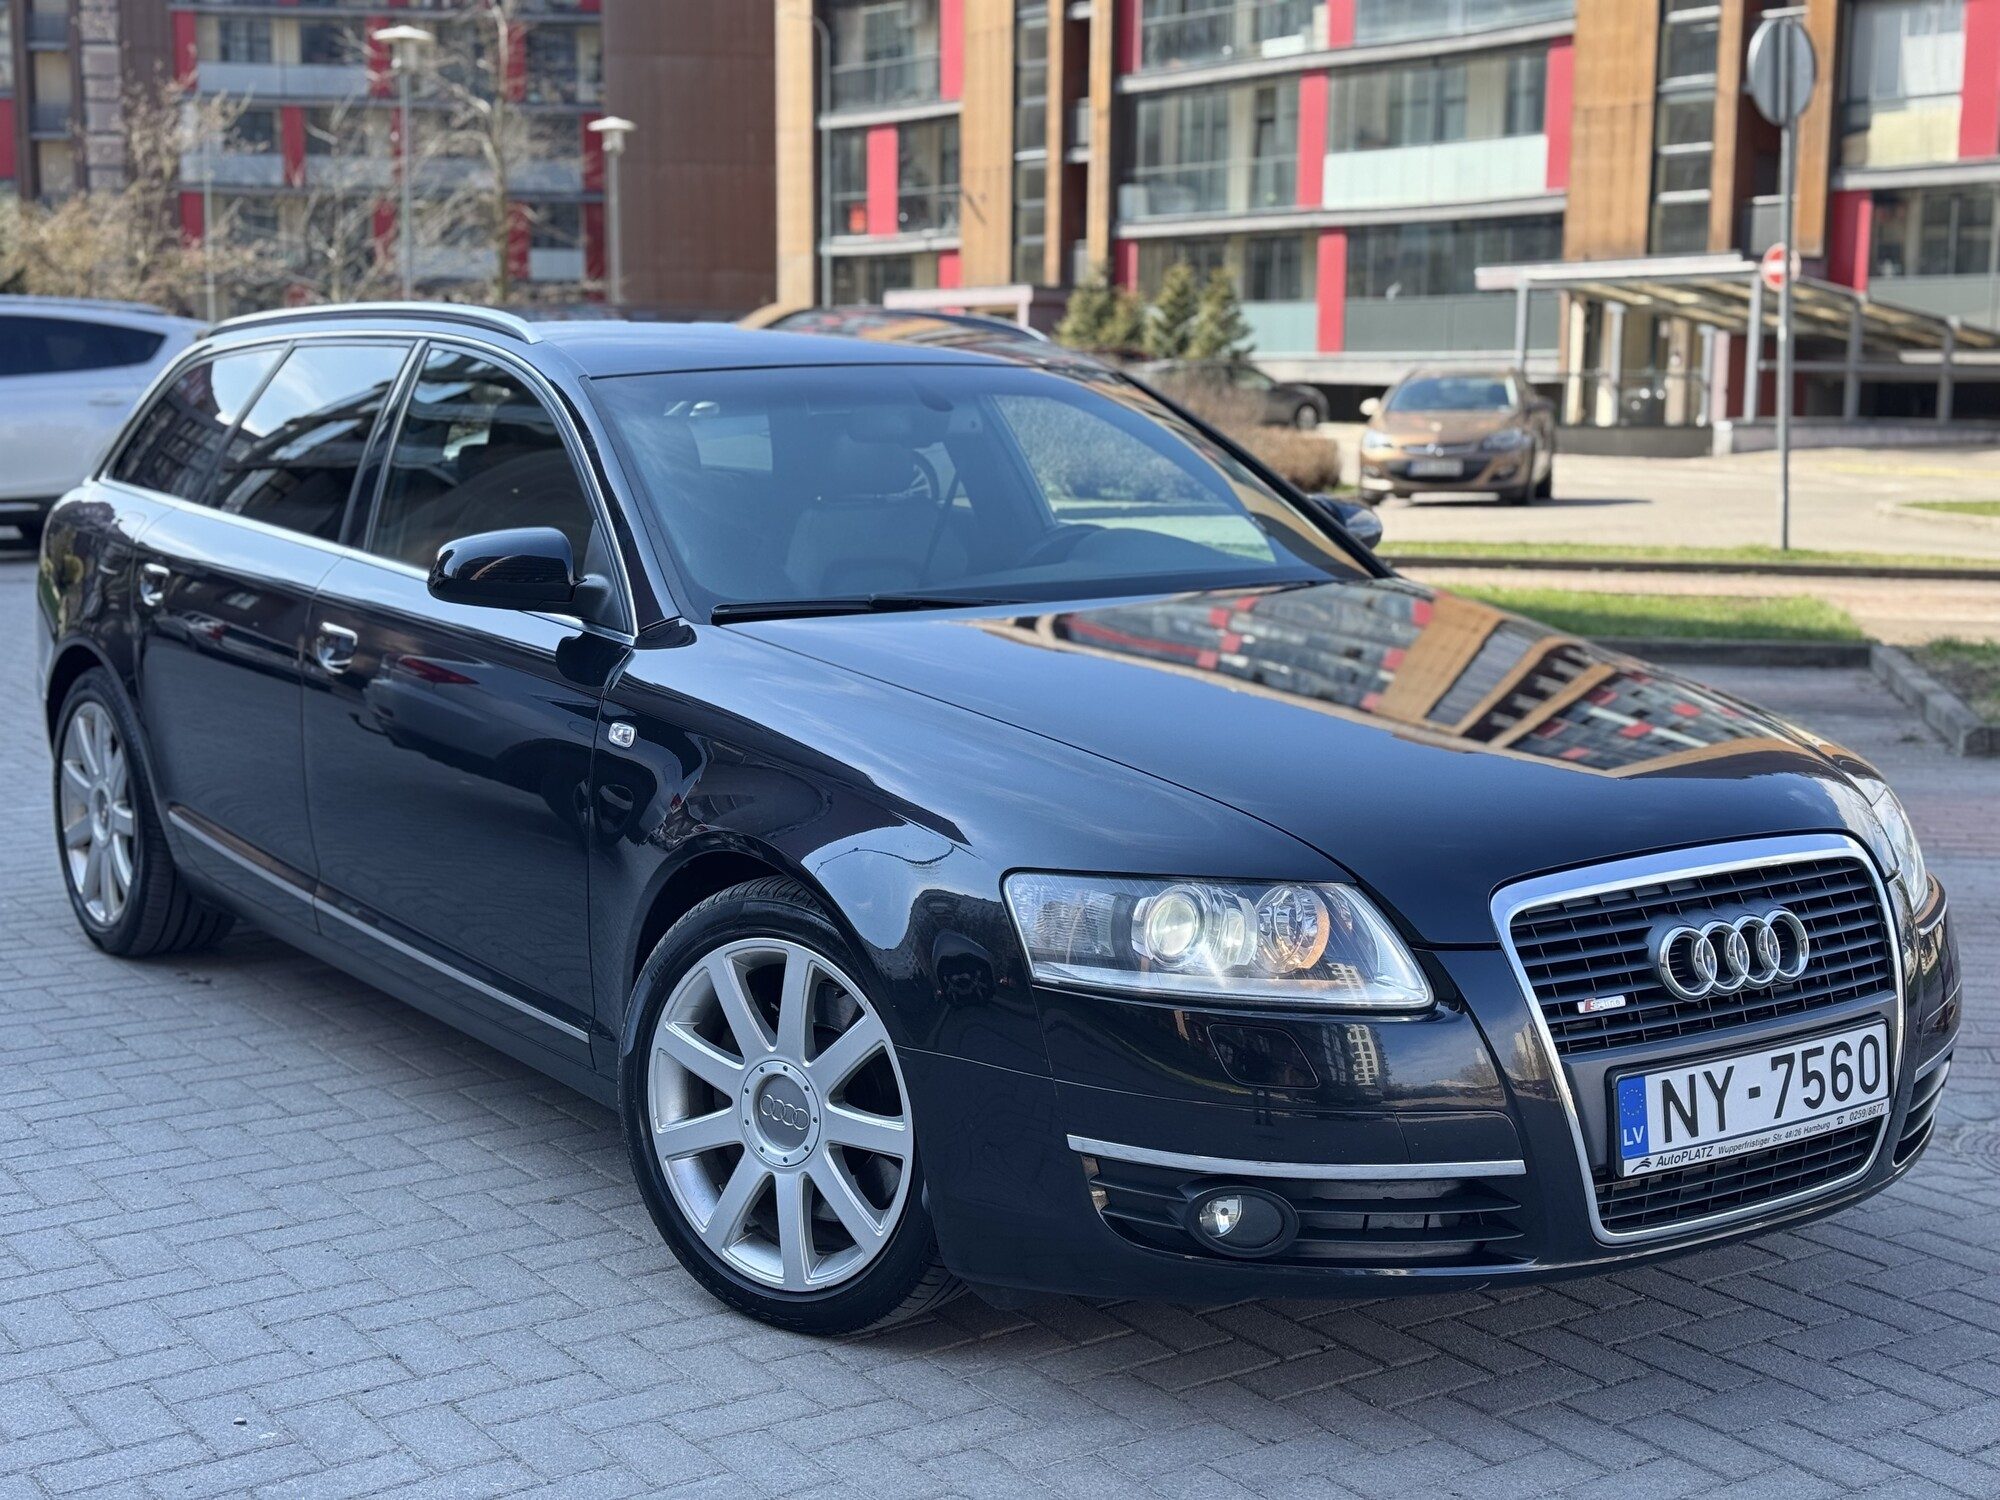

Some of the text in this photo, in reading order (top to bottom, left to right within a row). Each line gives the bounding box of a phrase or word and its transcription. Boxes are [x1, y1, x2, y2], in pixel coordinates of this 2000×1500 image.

[1623, 1125, 1644, 1146] LV
[1655, 1146, 1714, 1167] AutoPLATZ
[1803, 1122, 1831, 1134] Hamburg
